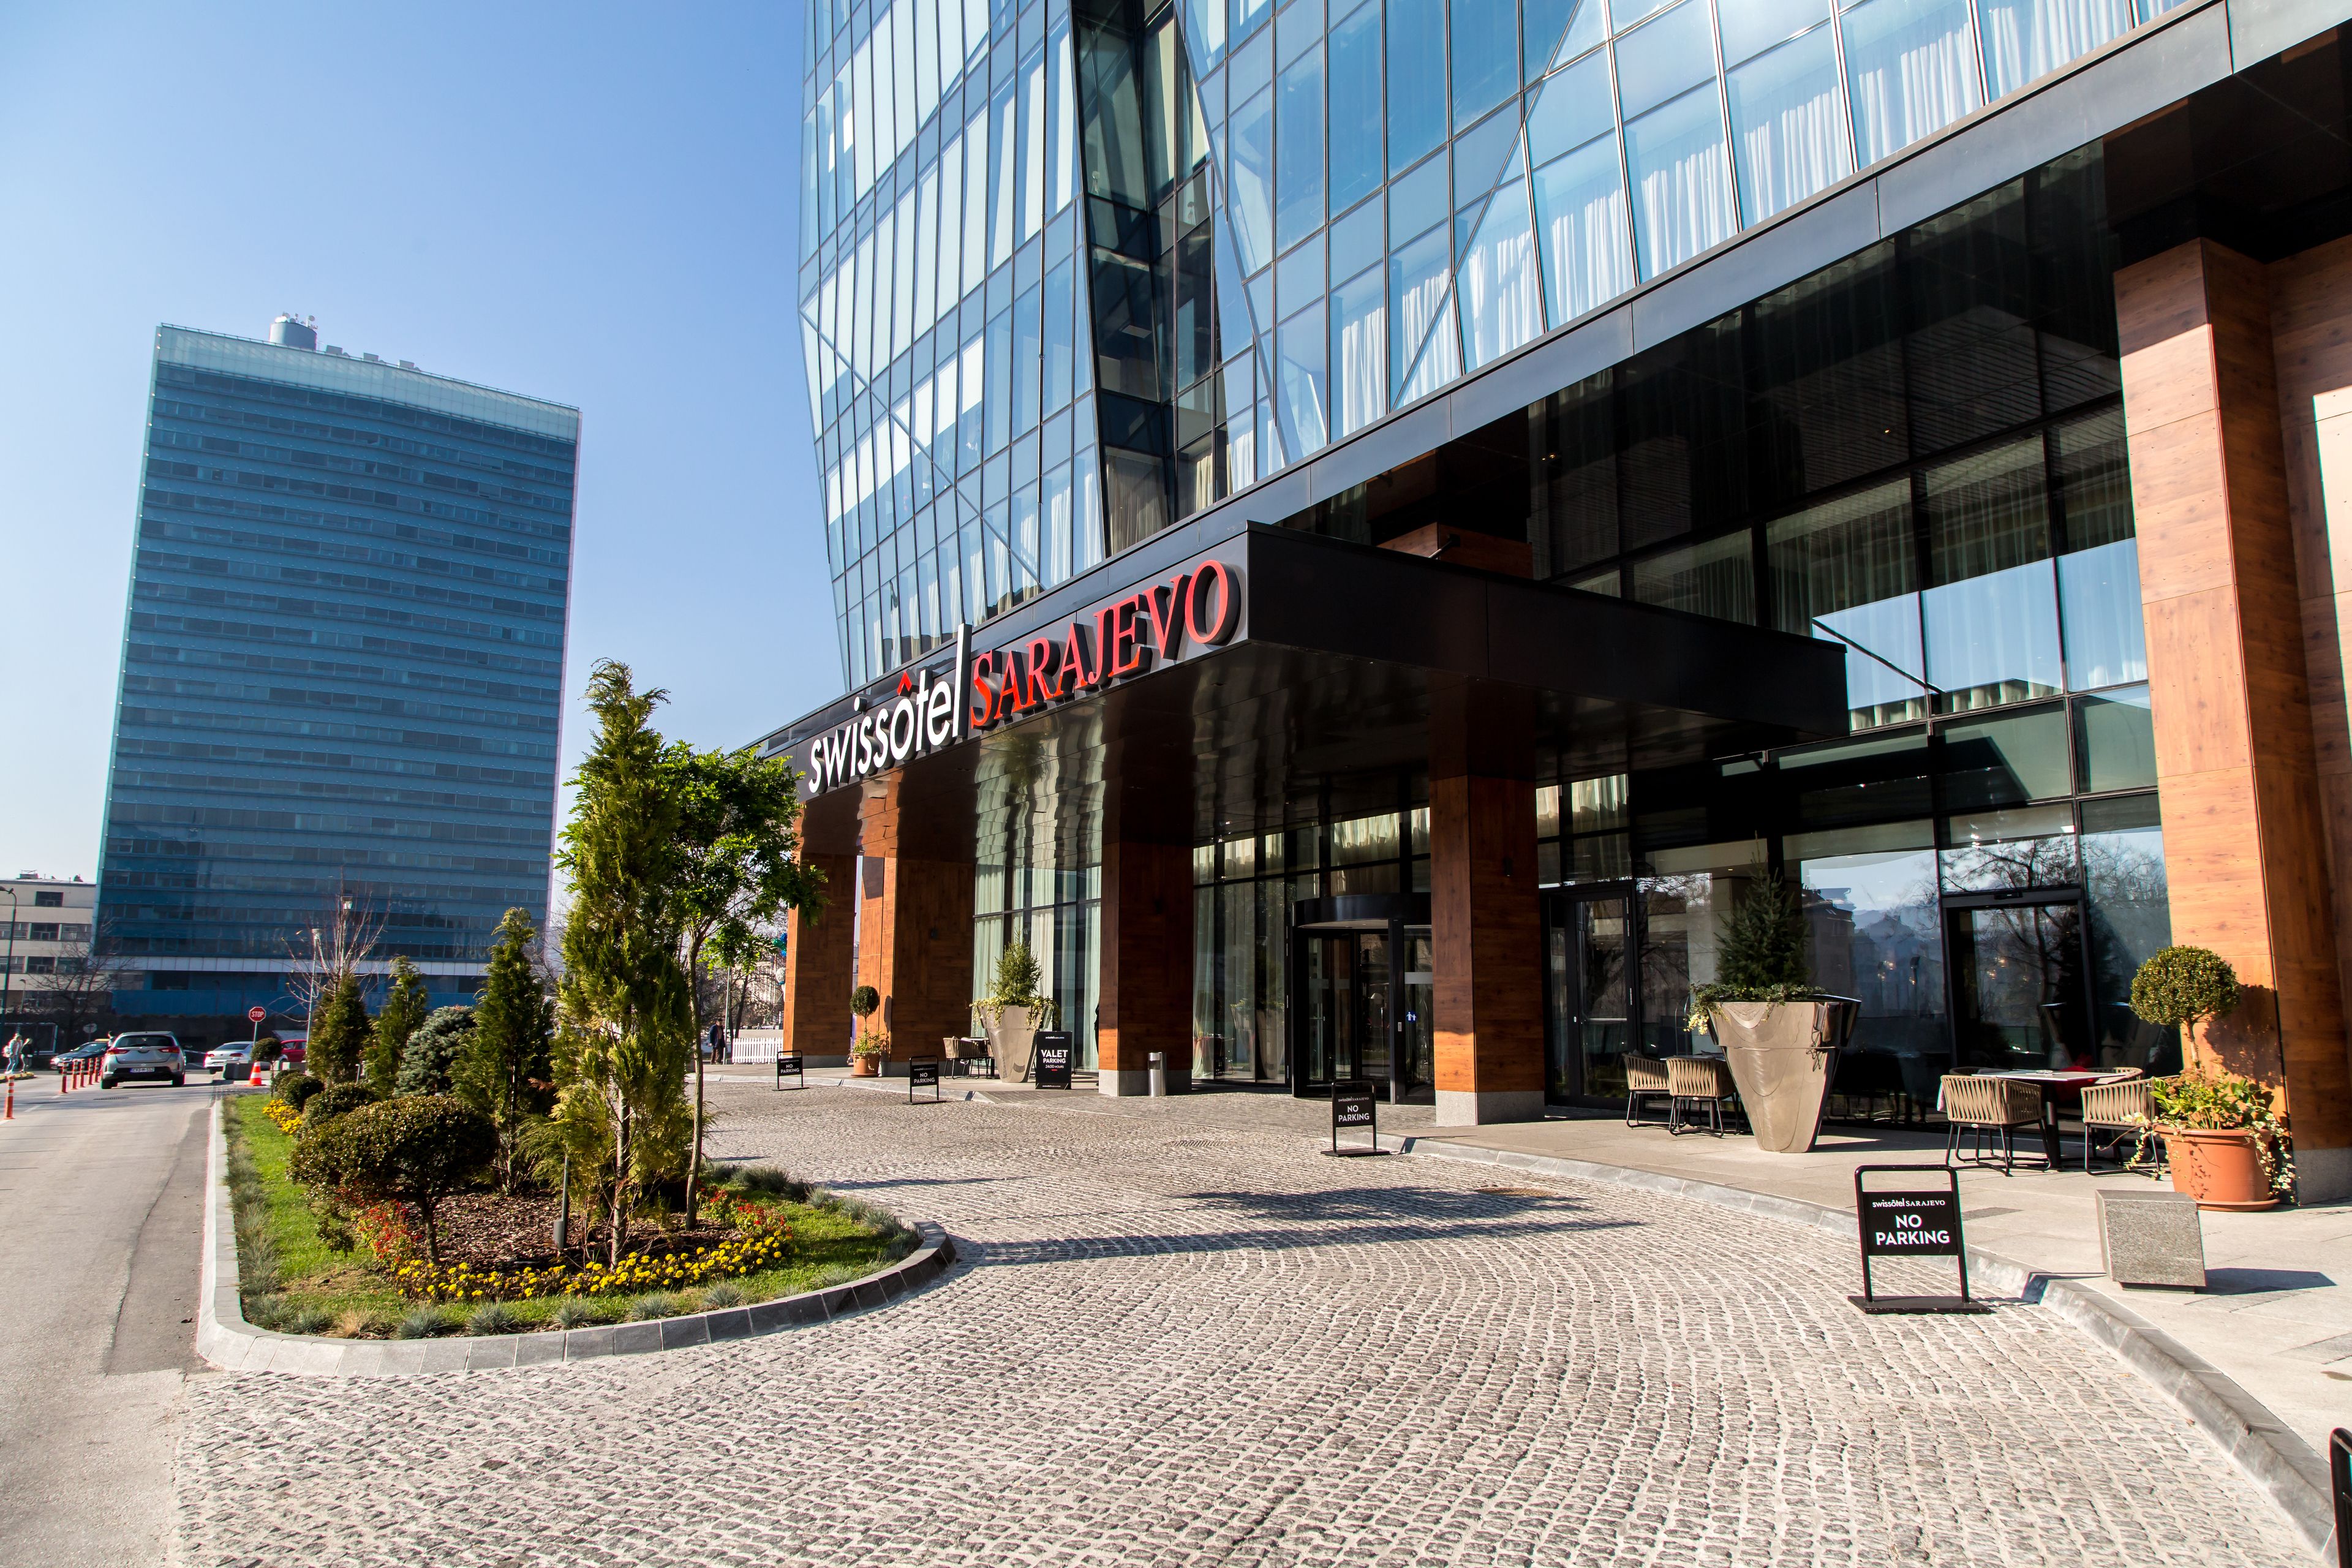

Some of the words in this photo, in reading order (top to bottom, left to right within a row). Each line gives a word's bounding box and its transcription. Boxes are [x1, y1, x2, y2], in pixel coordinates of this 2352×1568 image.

[809, 623, 972, 793] swissôtel
[971, 559, 1232, 729] SARAJEVO
[1041, 1049, 1068, 1058] VALET
[1347, 1104, 1359, 1113] NO
[1338, 1113, 1370, 1122] PARKING
[1872, 1197, 1905, 1208] swissôtel
[1895, 1214, 1923, 1229] NO
[1875, 1230, 1951, 1246] PARKING
